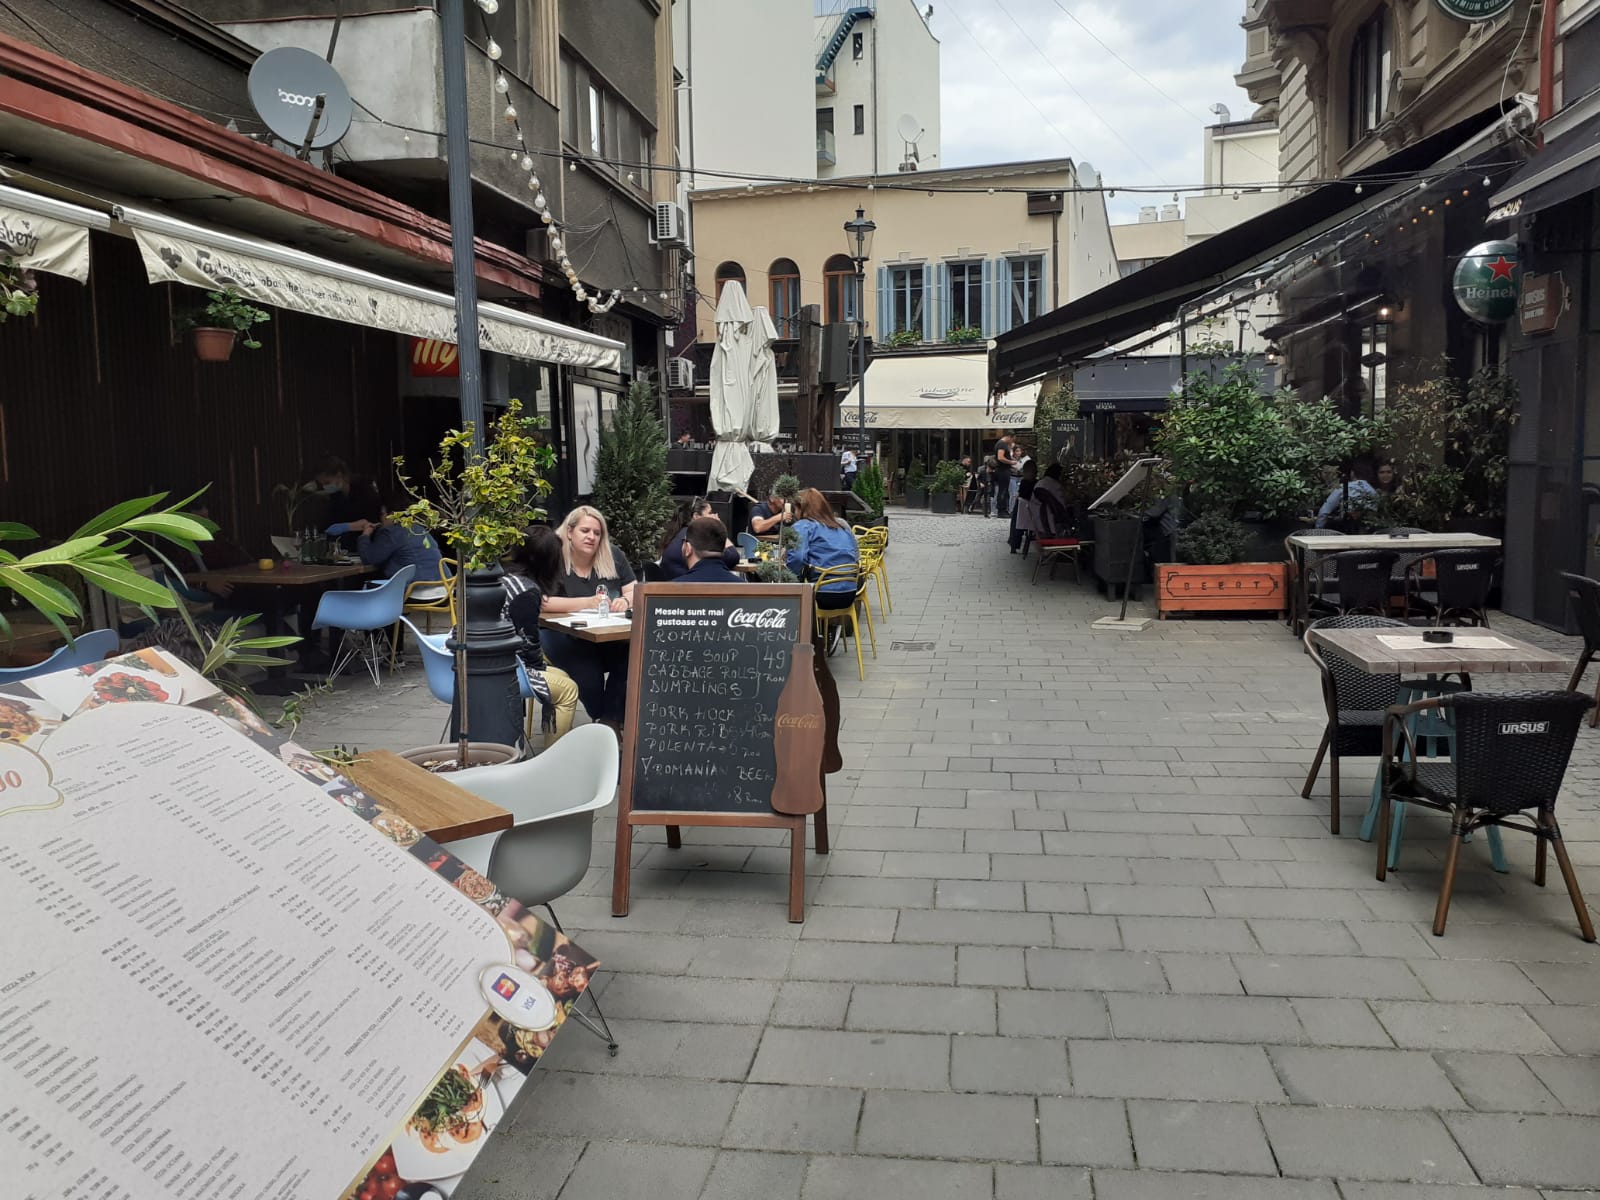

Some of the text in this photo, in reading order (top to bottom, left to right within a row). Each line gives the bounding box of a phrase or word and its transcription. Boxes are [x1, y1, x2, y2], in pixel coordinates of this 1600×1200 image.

[1466, 287, 1517, 299] Heinek
[412, 339, 459, 373] illy
[992, 411, 1030, 424] Coca-Cola
[654, 608, 724, 617] Mesele sunt mai
[727, 607, 791, 629] Coca-Cola
[656, 618, 718, 627] gustoase cu o
[653, 629, 799, 643] ROMANIAN MENU
[649, 649, 694, 662] TRIPE
[703, 648, 739, 663] SOUP
[648, 664, 713, 678] CABBAGE
[650, 680, 744, 697] DUMPLINGS
[646, 702, 688, 720] PORK
[777, 713, 817, 729] Coca-Cola
[645, 722, 690, 736] PORK
[1501, 723, 1546, 735] URSUS
[644, 737, 716, 753] POLENTA
